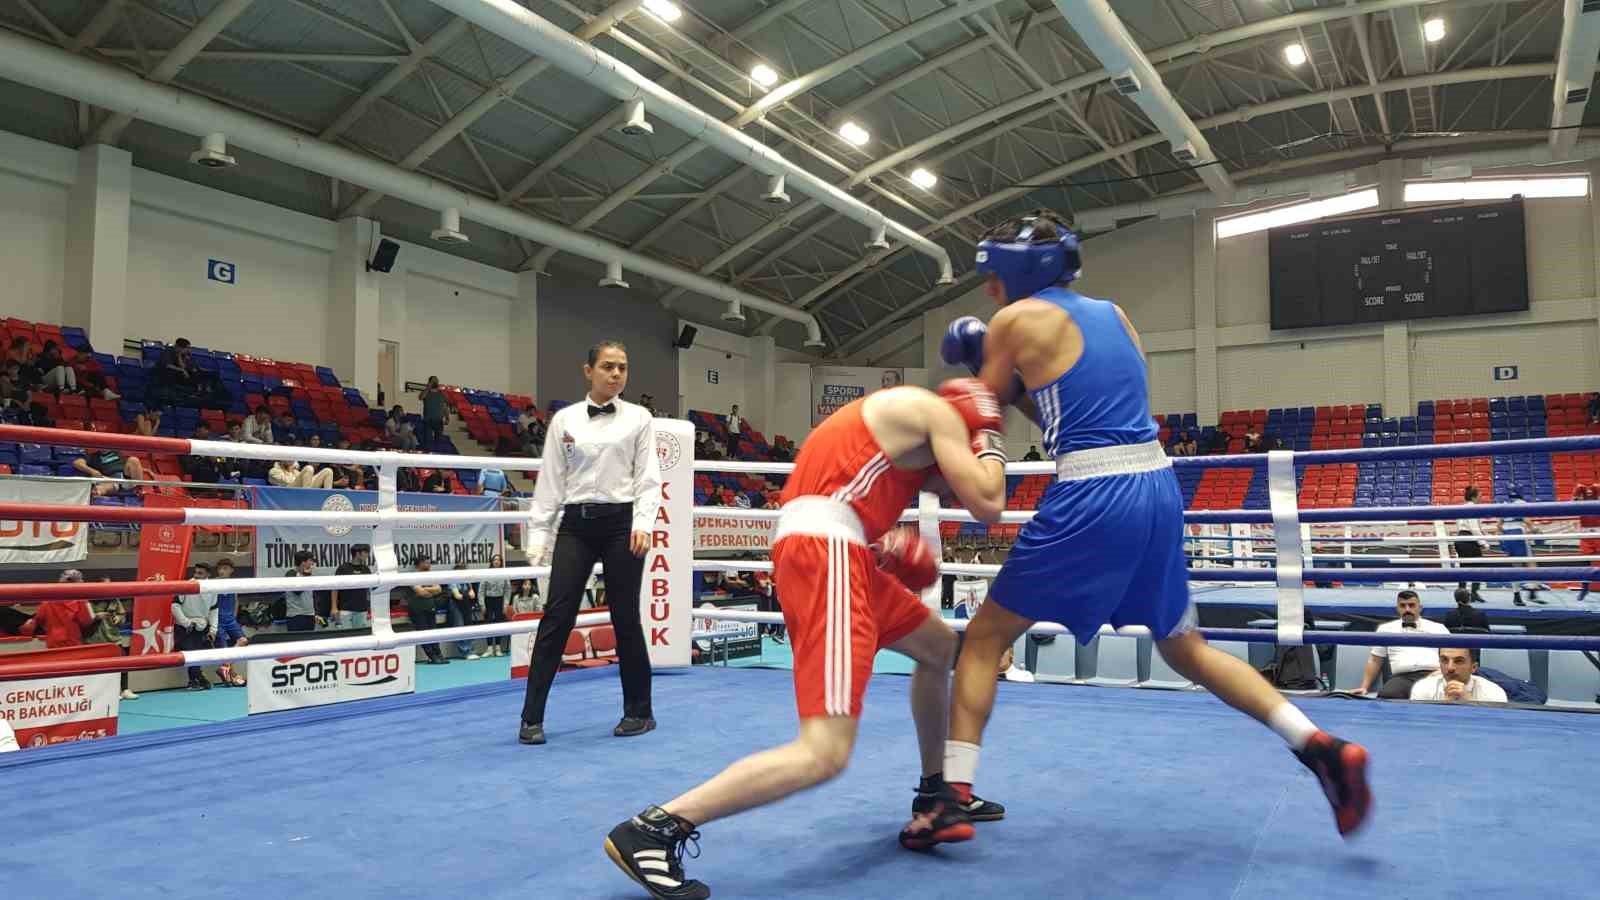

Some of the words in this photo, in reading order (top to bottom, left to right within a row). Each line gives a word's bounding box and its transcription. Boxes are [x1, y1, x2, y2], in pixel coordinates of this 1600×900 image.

[214, 262, 232, 282] G
[1499, 367, 1514, 380] D
[700, 534, 769, 547] FEDERATION
[265, 537, 297, 569] TÜM
[394, 543, 451, 568] AŞARILAR
[650, 481, 671, 646] KARABÜK
[6, 685, 66, 705] GENÇLİK
[68, 684, 85, 698] VE
[19, 698, 92, 719] BAKANLIĞI
